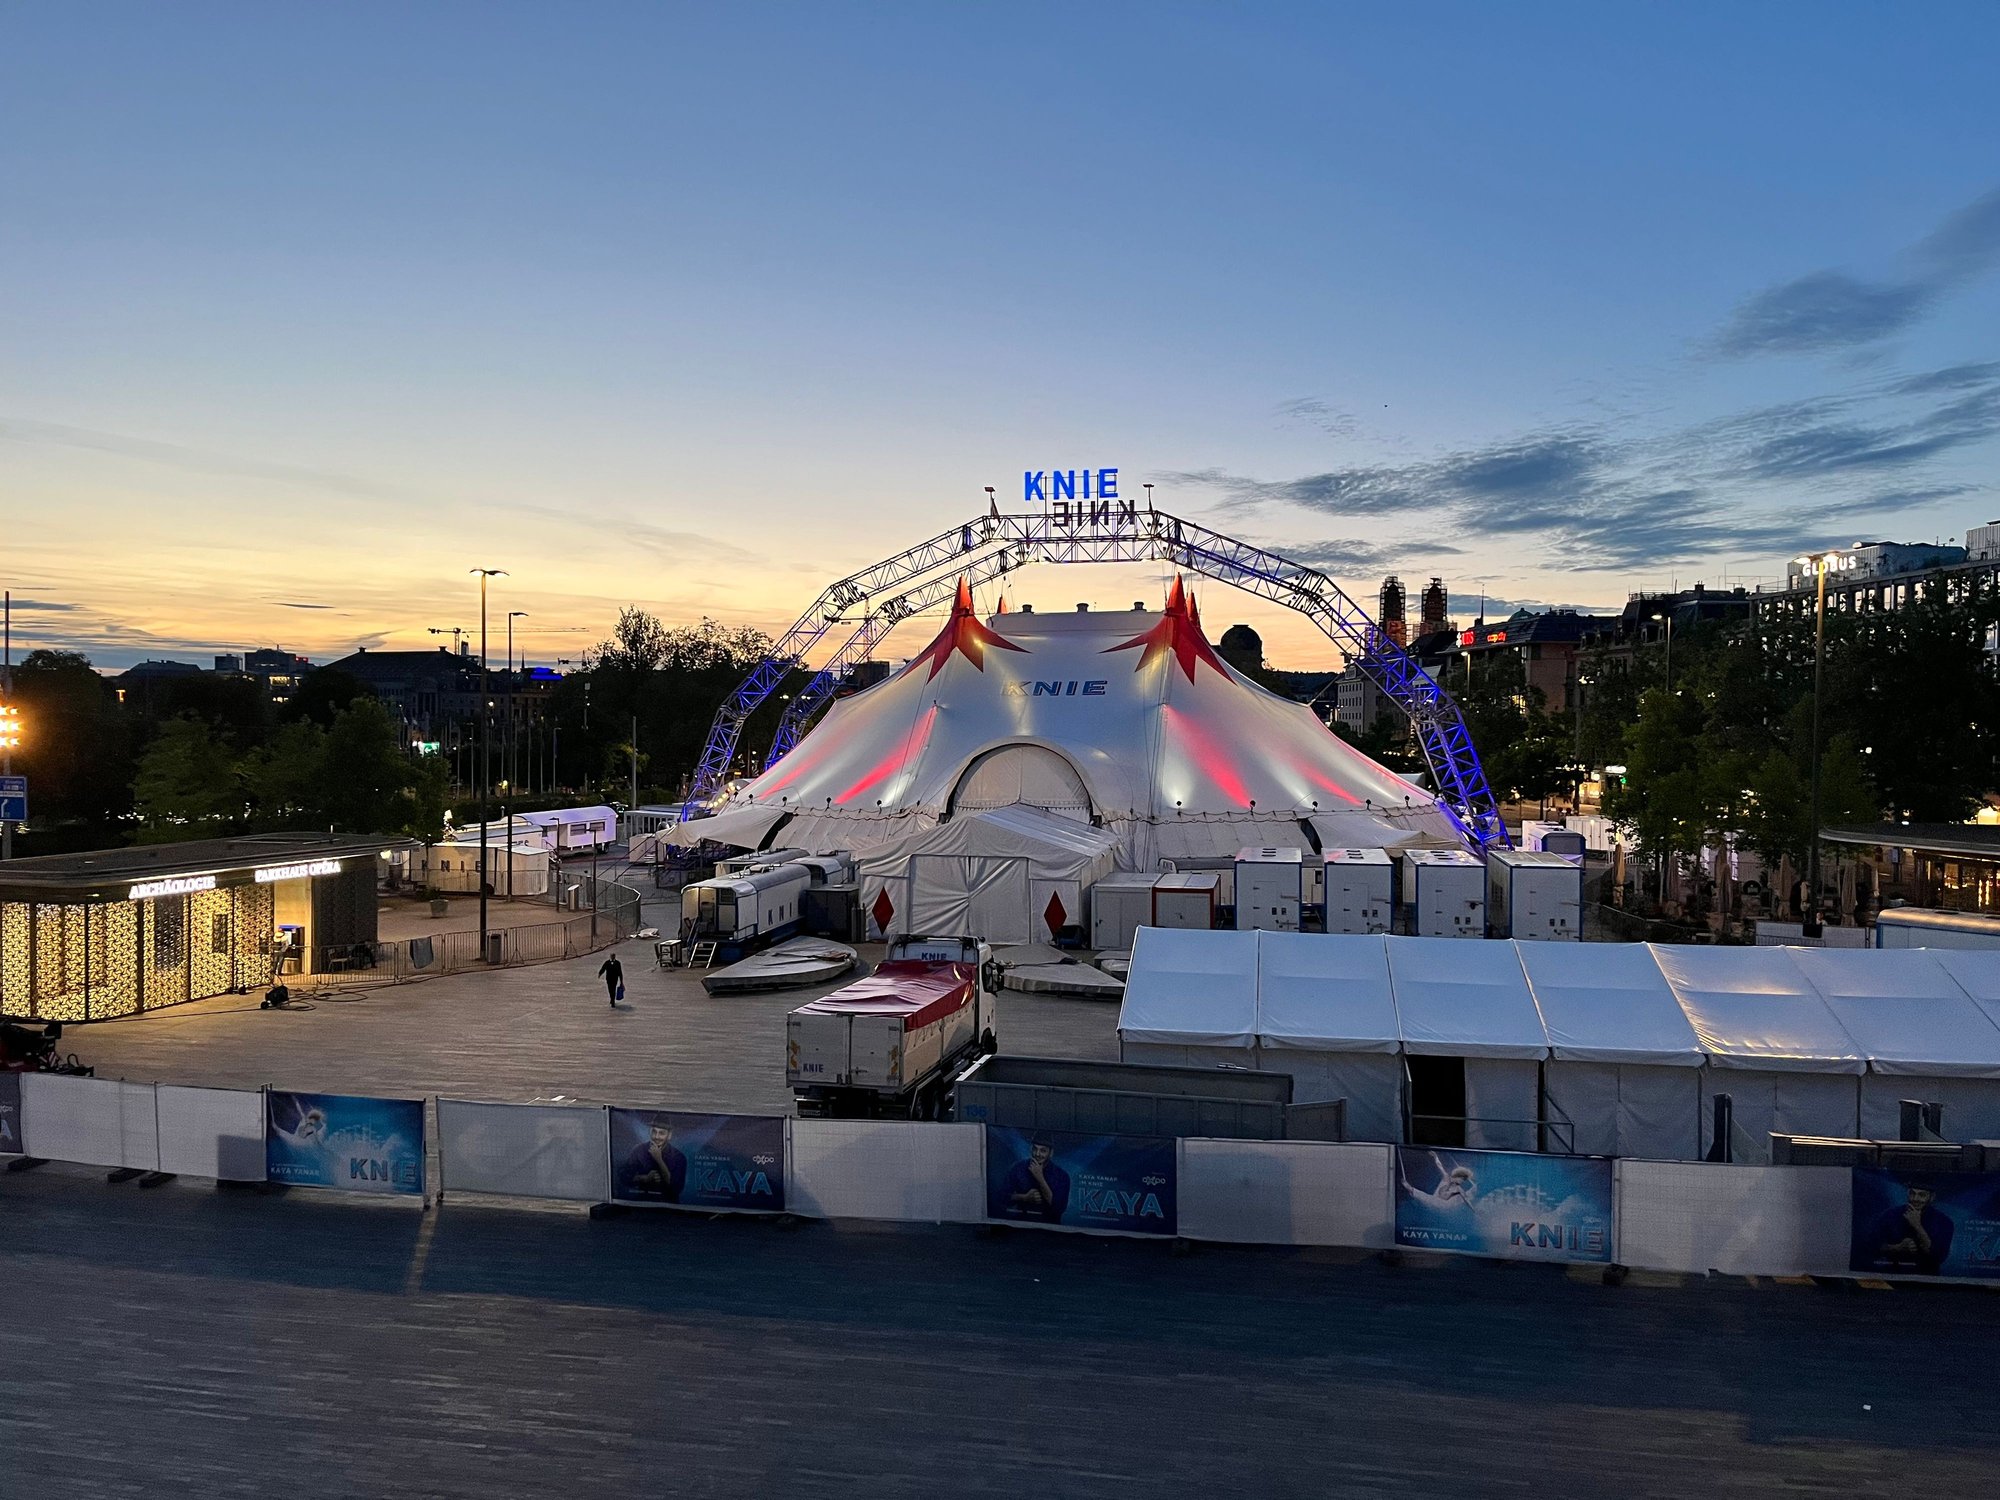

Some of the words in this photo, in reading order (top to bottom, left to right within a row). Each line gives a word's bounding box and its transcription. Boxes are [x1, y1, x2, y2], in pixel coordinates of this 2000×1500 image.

[1024, 468, 1118, 501] KNIE
[1001, 680, 1108, 697] KNIE
[128, 875, 216, 899] ARCHÄOLOGIE
[768, 902, 792, 926] KNI
[921, 952, 947, 961] KNIE
[803, 1063, 824, 1073] KNIE
[350, 1157, 417, 1184] KNIE
[694, 1167, 773, 1196] KAYA
[1078, 1187, 1165, 1219] KAYA
[1402, 1230, 1430, 1240] KAYA
[1432, 1232, 1468, 1241] YANAR
[1510, 1221, 1604, 1256] KNIE
